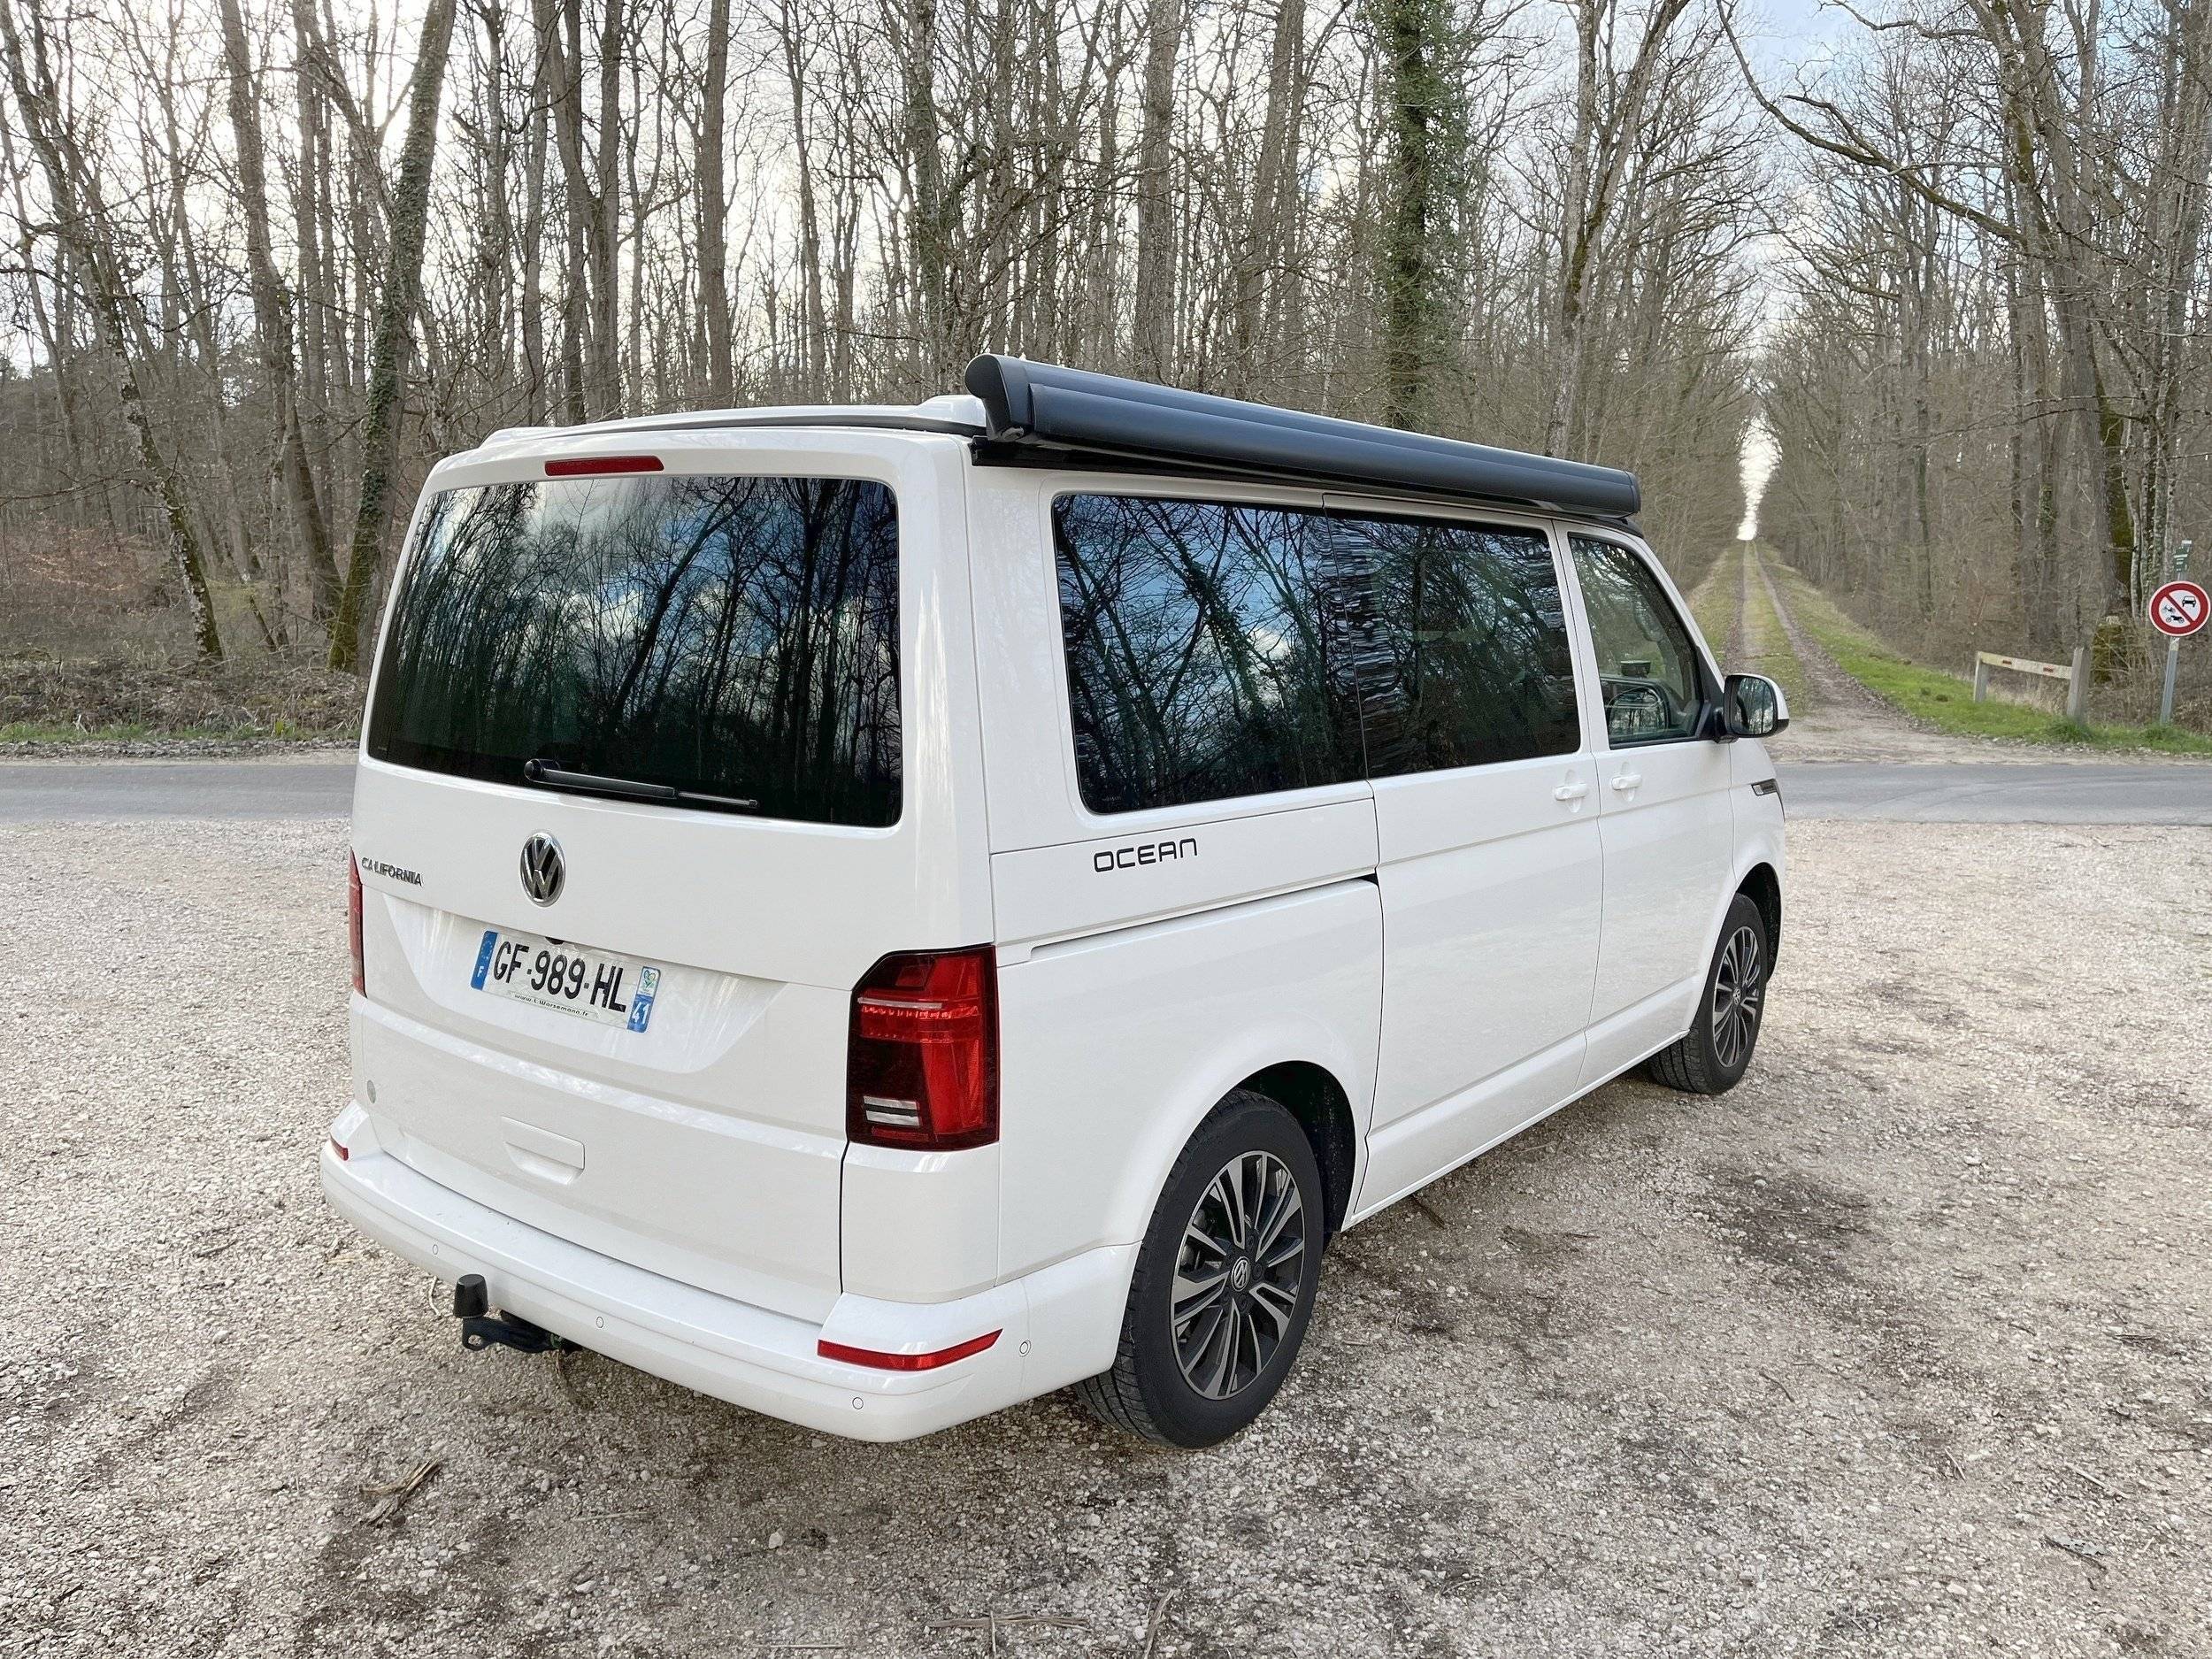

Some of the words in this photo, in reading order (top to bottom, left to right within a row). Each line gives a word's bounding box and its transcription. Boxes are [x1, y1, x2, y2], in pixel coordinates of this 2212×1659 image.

[1094, 839, 1197, 872] OCEAN
[361, 856, 422, 887] CALIFORNIA
[478, 966, 484, 977] F
[632, 1002, 649, 1024] 41
